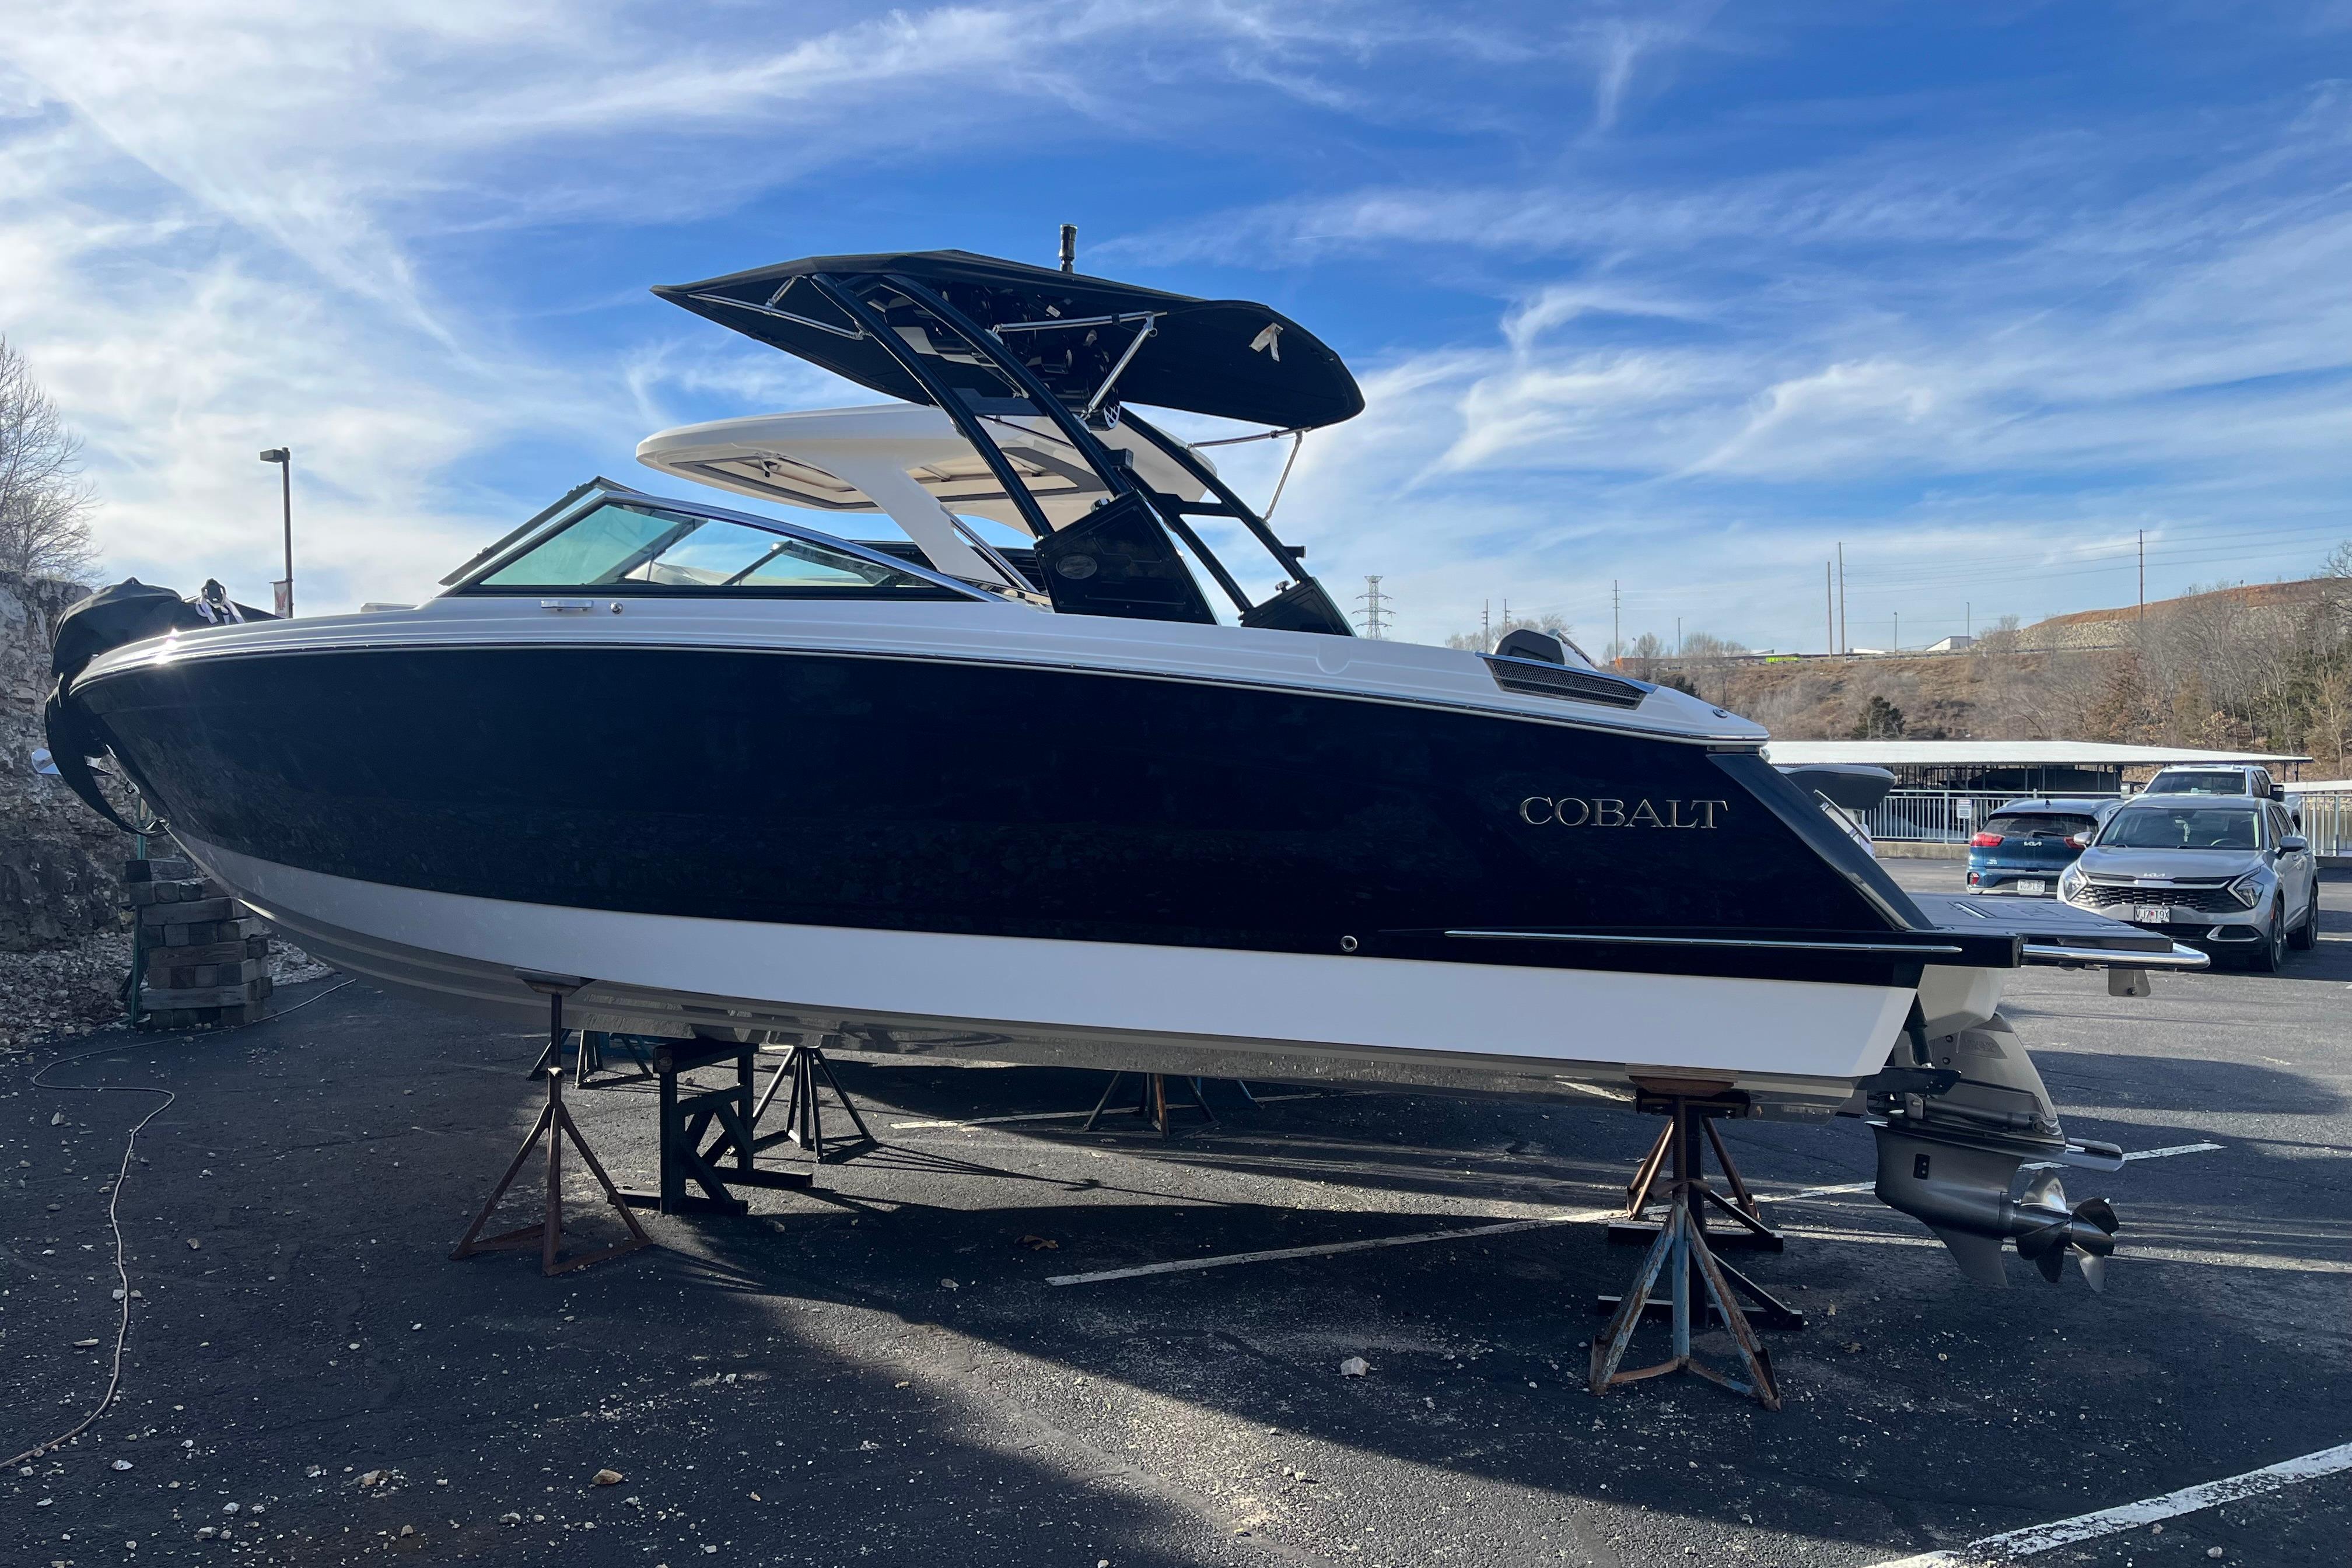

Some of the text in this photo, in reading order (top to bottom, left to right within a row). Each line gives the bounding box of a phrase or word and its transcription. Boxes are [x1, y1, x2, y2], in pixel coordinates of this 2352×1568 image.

[1518, 796, 1728, 829] COBALT
[2136, 909, 2169, 919] VJ7 T9X
